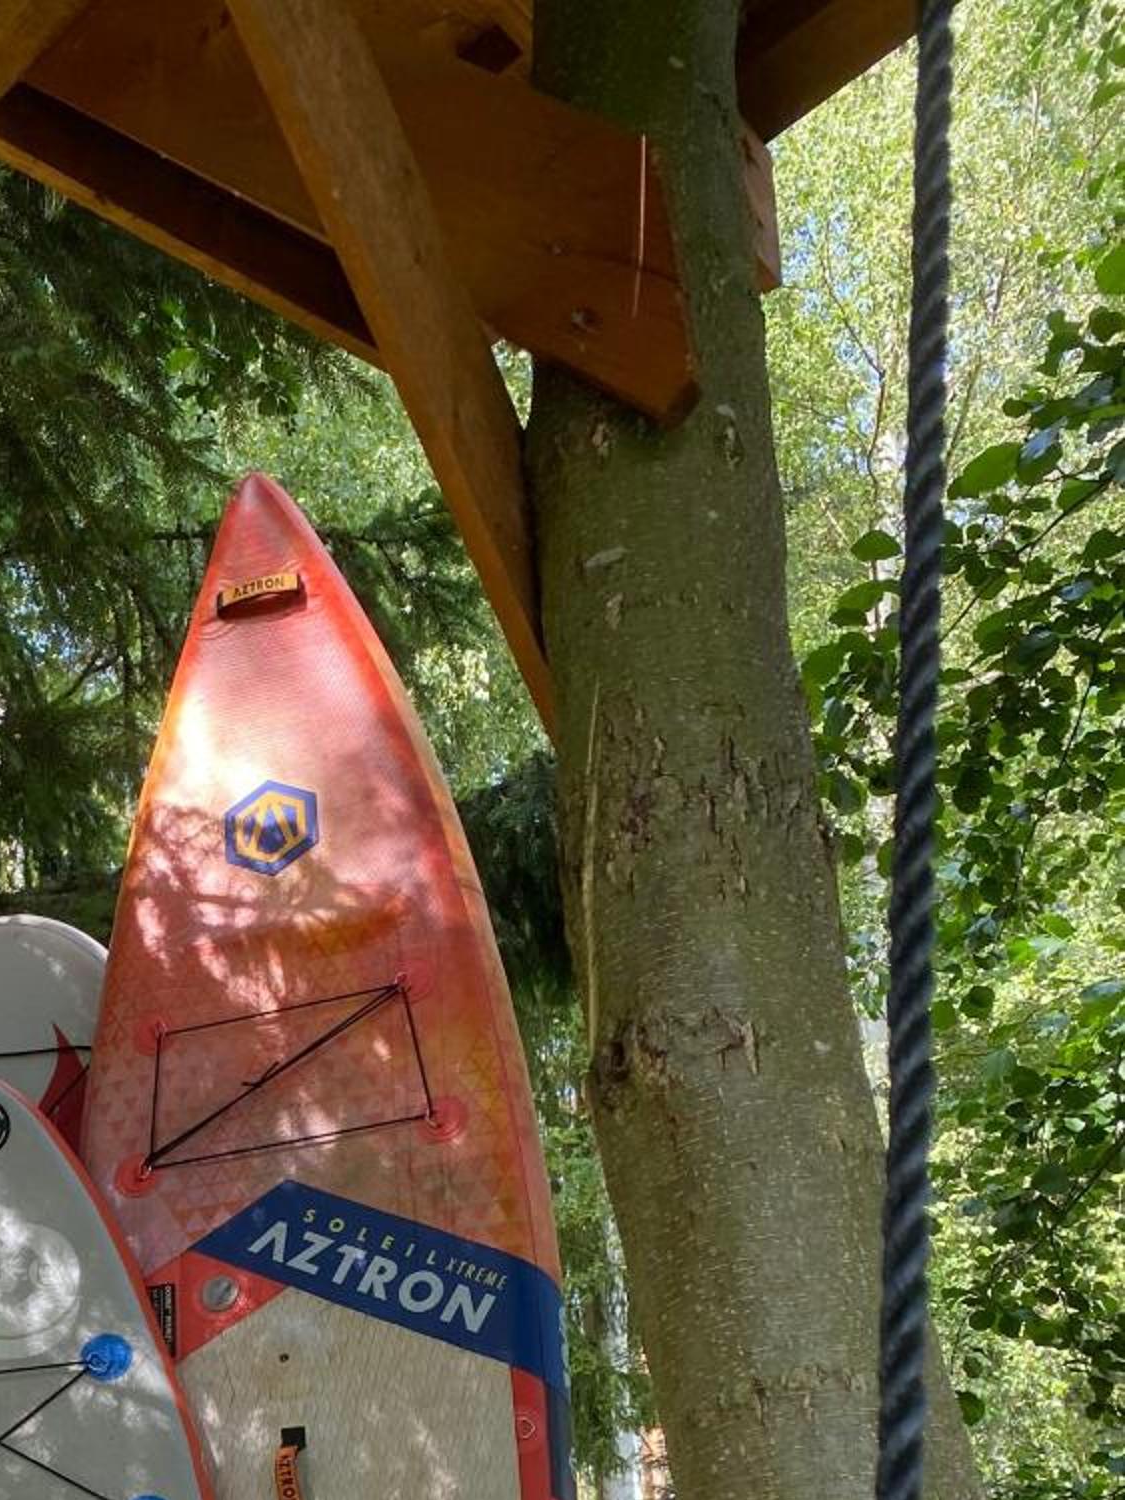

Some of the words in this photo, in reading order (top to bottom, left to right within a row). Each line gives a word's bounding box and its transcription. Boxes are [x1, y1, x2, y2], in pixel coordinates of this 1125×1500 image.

[233, 577, 284, 598] AZTRON
[247, 1220, 496, 1334] AZTRON
[303, 1209, 437, 1266] SOLEIL
[444, 1256, 507, 1290] XTREME
